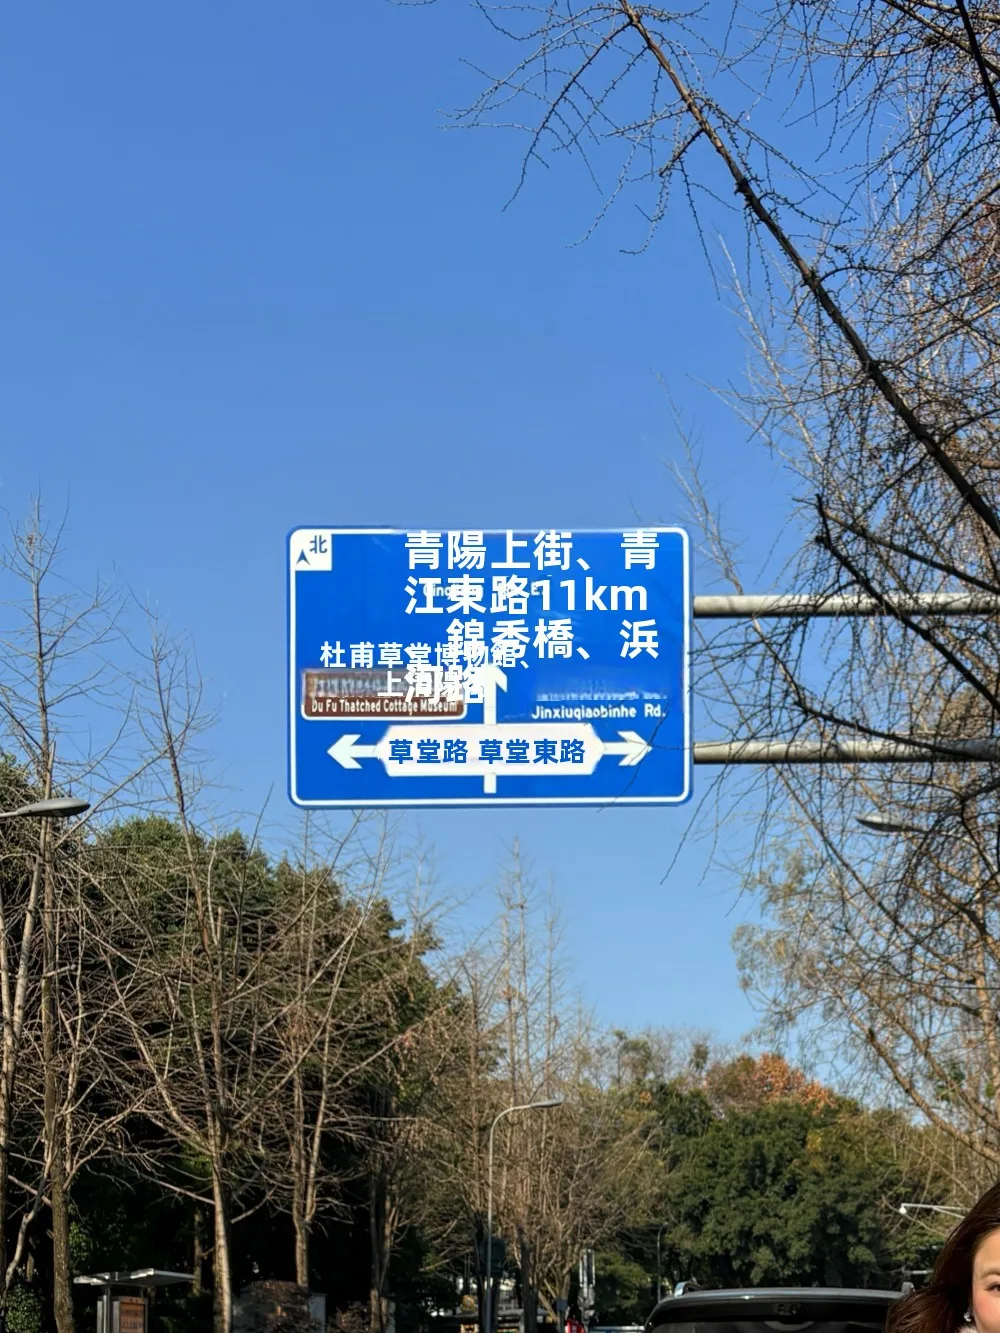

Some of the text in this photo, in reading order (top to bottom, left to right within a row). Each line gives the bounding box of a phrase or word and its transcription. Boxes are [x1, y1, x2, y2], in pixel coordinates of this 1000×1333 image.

[309, 534, 328, 554] 北
[311, 698, 458, 716] Du Fu Thatched Cottage Museum
[531, 703, 667, 721] Jinxiuqiaobinhe Rd.
